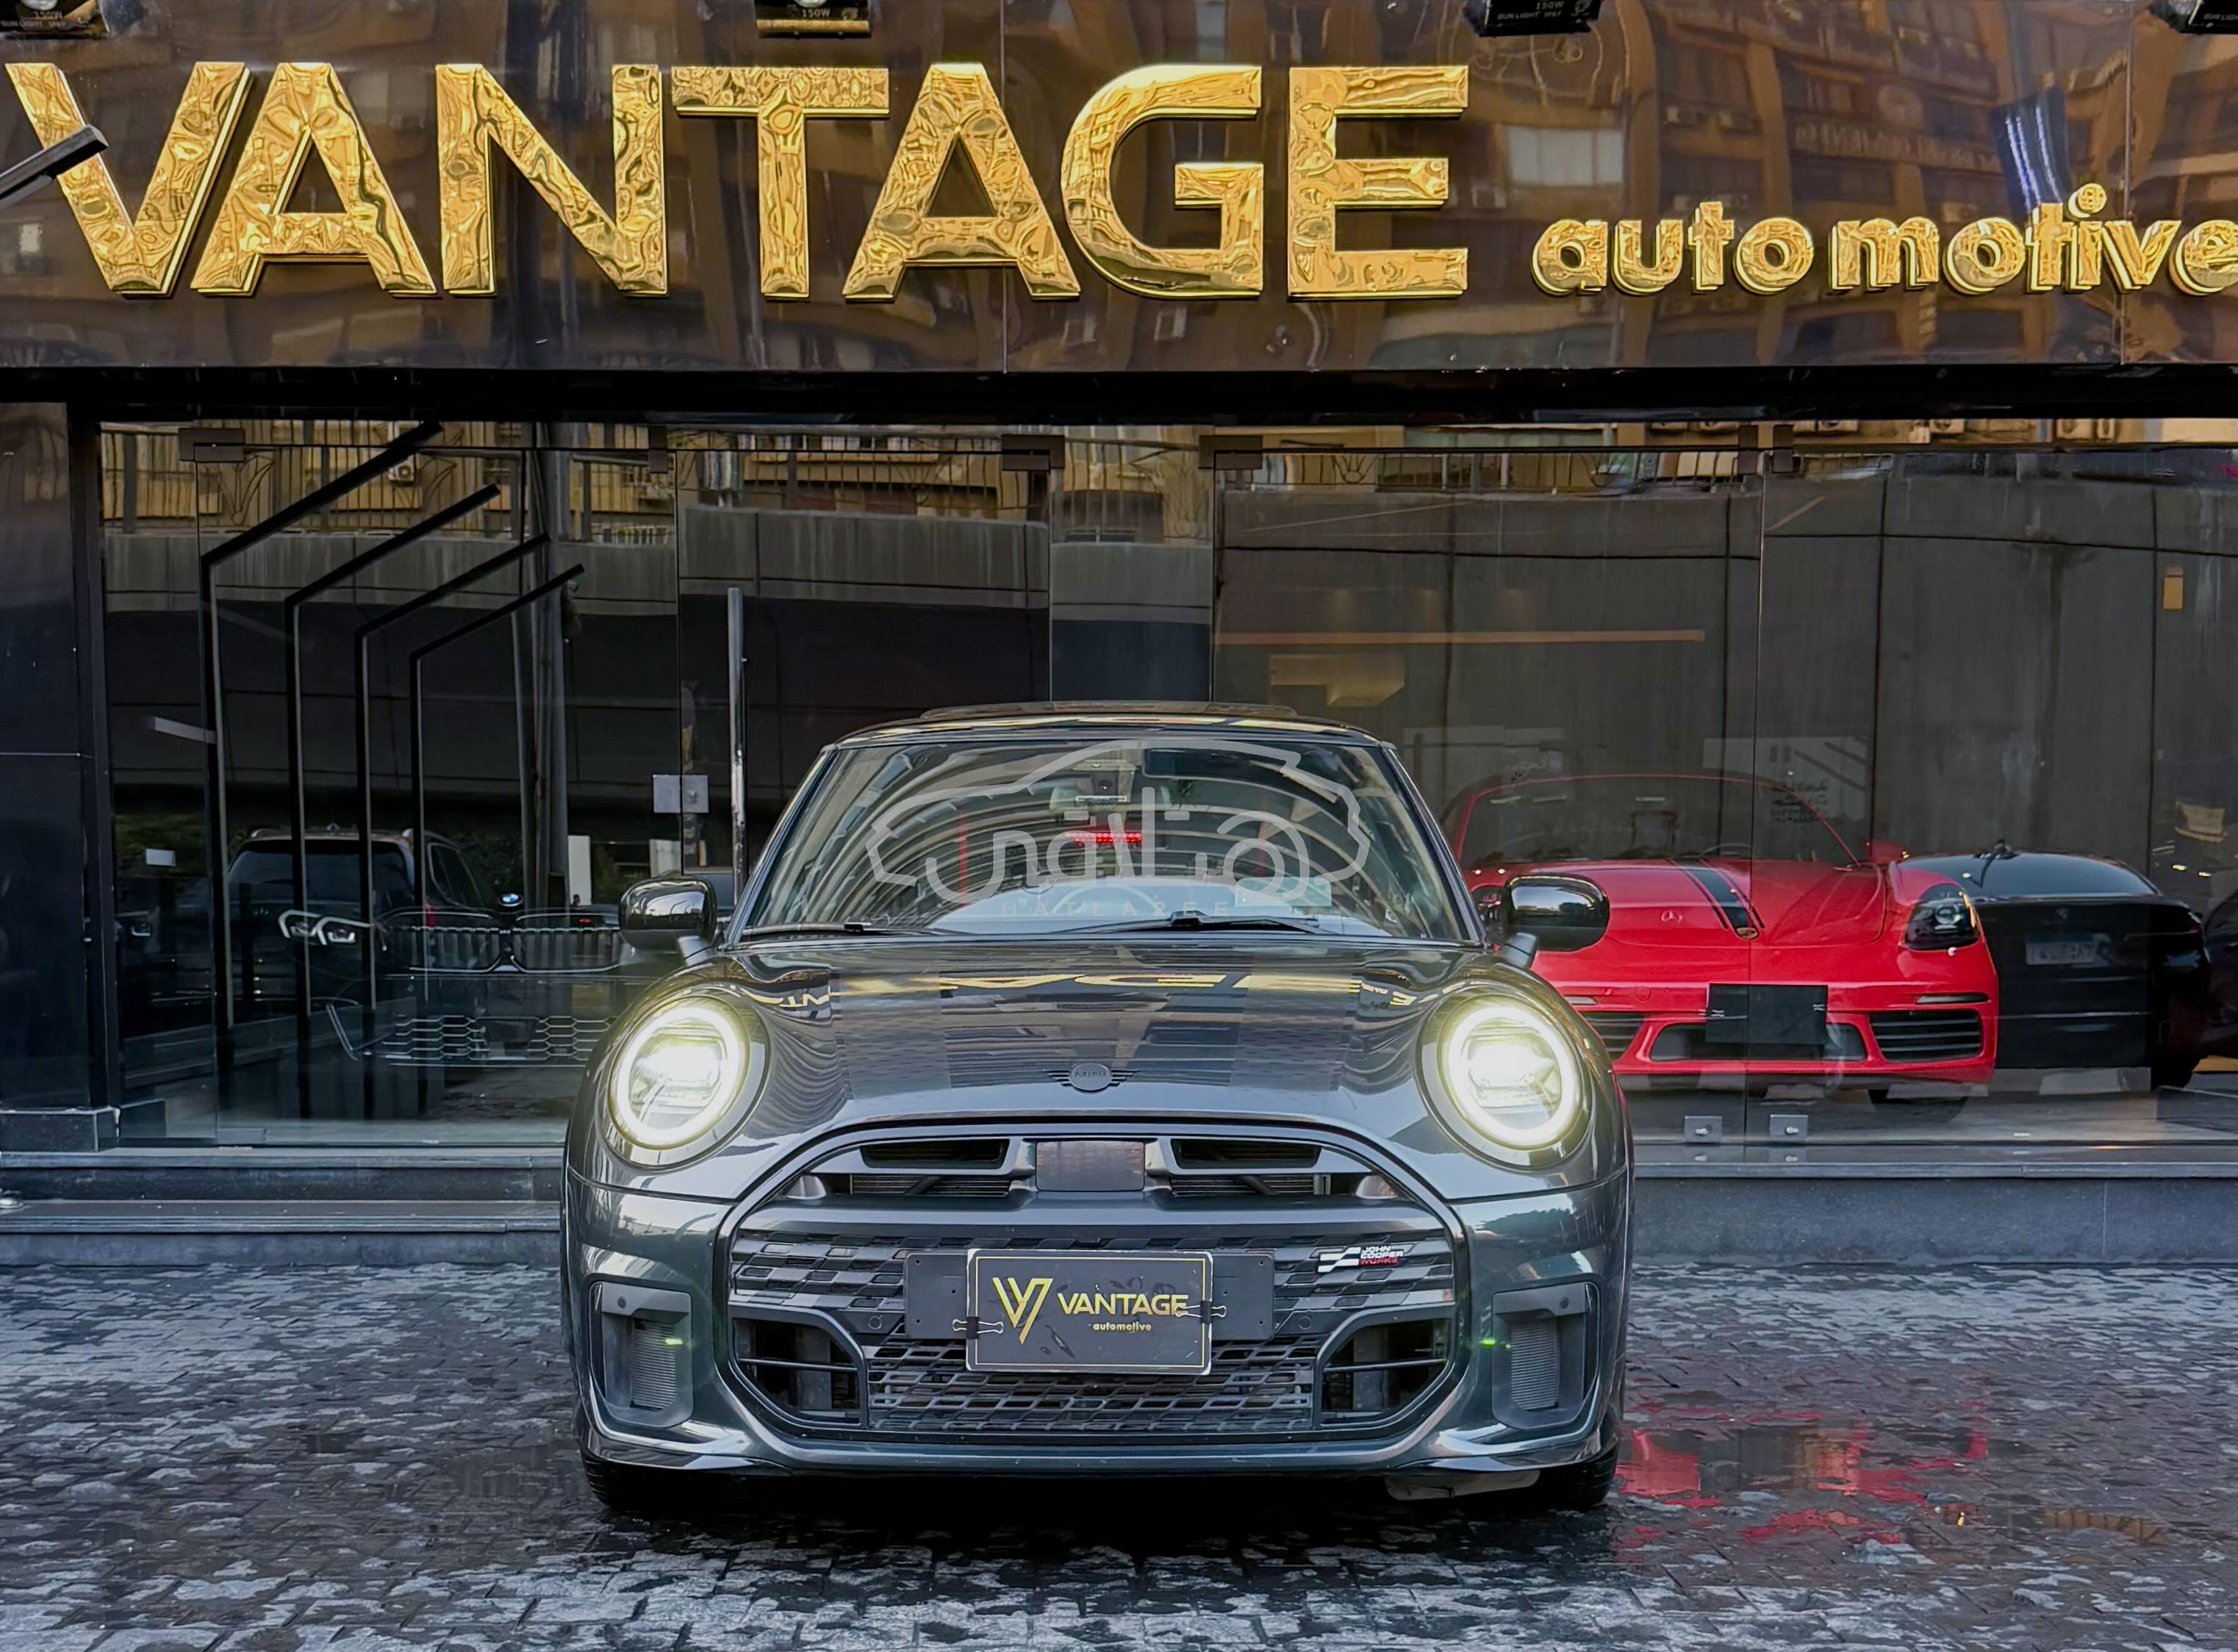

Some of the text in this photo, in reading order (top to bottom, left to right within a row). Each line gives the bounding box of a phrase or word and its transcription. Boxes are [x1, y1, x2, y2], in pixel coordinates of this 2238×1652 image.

[802, 8, 831, 18] 150W
[1536, 1, 1564, 10] 150W
[6, 61, 1470, 301] VANTAGE
[1532, 183, 2238, 295] automotive
[1057, 1293, 1189, 1316] VANTAGE
[1092, 1322, 1152, 1332] automotive
